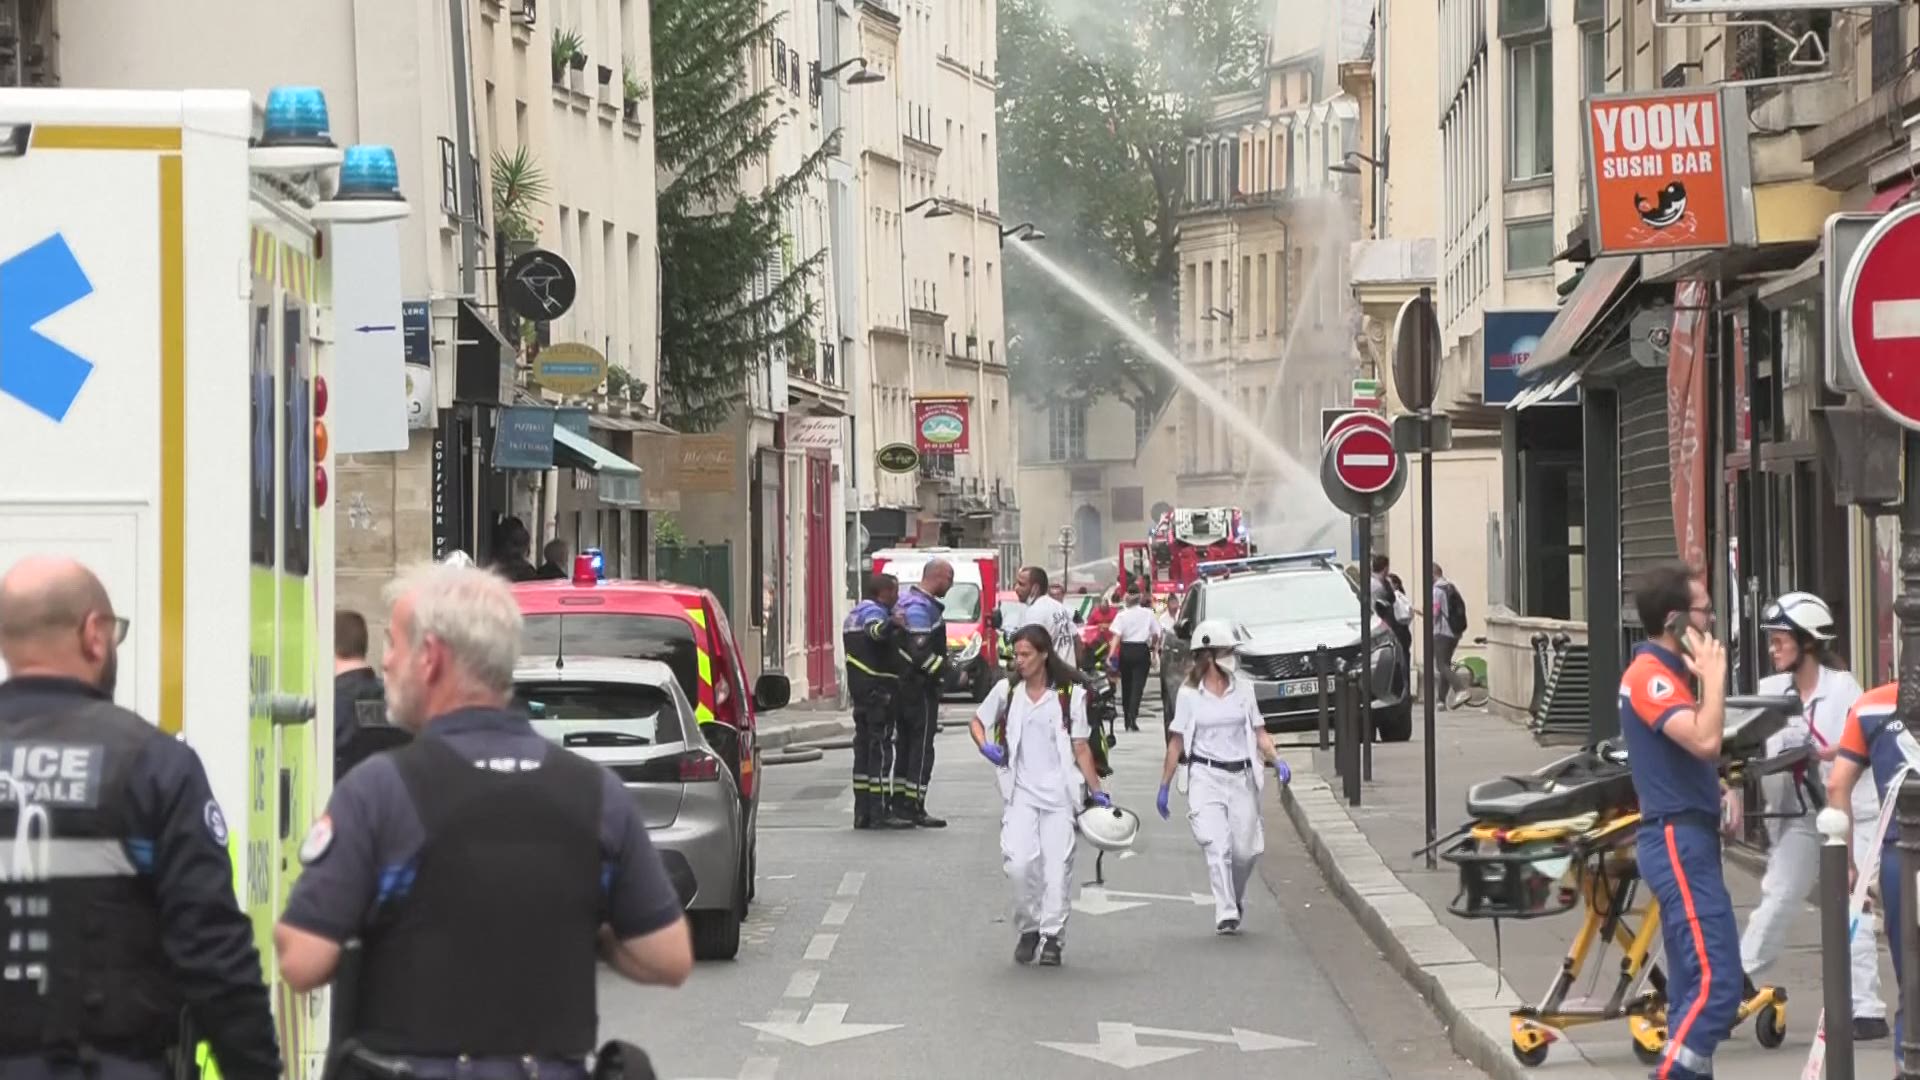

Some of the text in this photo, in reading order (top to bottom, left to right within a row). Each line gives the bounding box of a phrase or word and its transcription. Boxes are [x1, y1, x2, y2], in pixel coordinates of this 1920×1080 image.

[1593, 101, 1716, 152] YOOKI
[1603, 151, 1713, 179] SUSHI BAR
